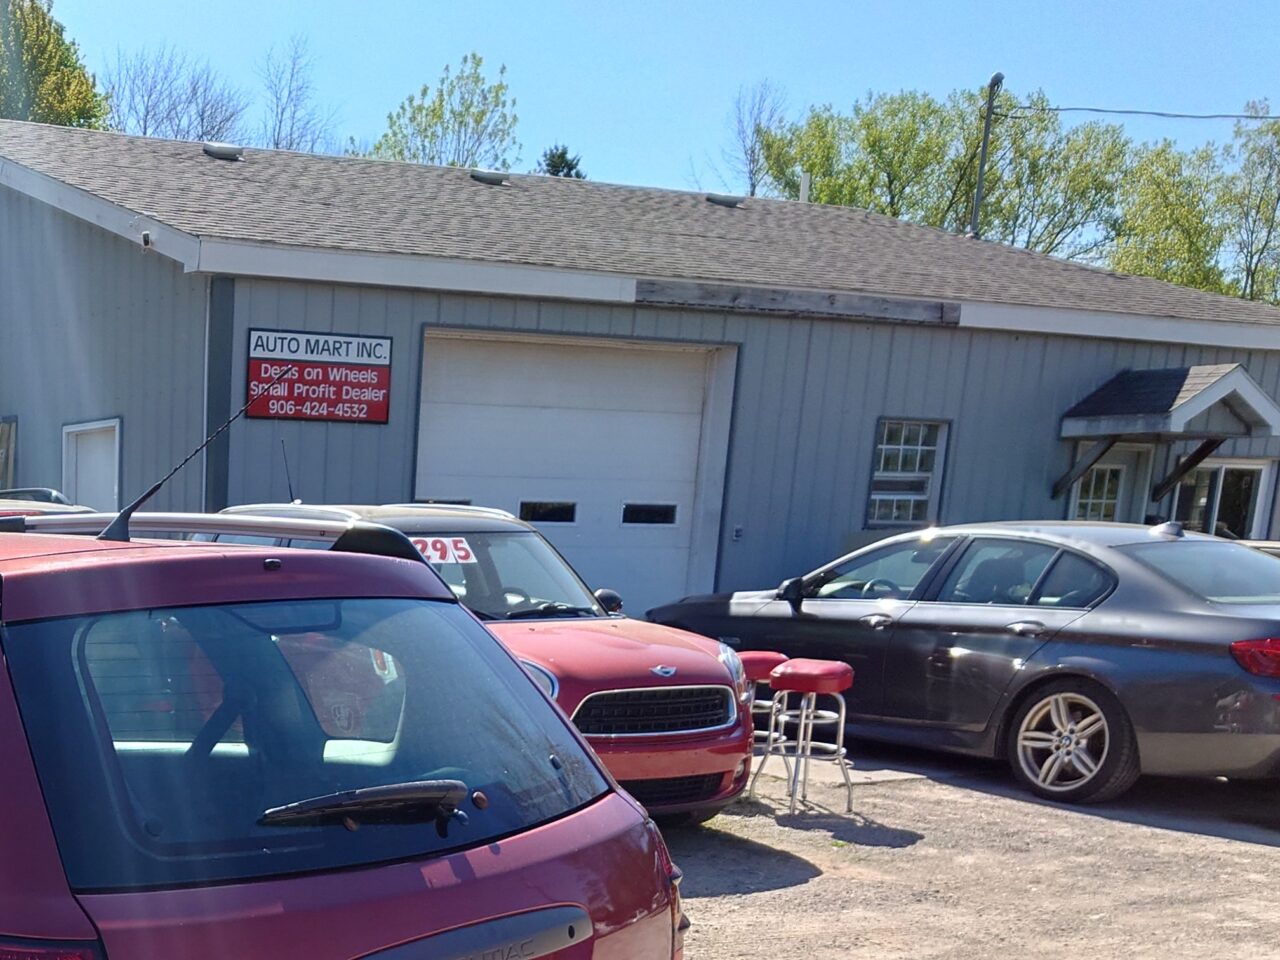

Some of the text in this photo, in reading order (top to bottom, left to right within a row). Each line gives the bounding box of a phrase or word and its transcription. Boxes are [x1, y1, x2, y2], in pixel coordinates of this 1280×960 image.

[252, 335, 388, 360] AUTO MART INC.
[260, 363, 378, 384] Deals on Wheels
[249, 380, 387, 402] Small Profit Dealer
[268, 399, 368, 418] 906-424-4532
